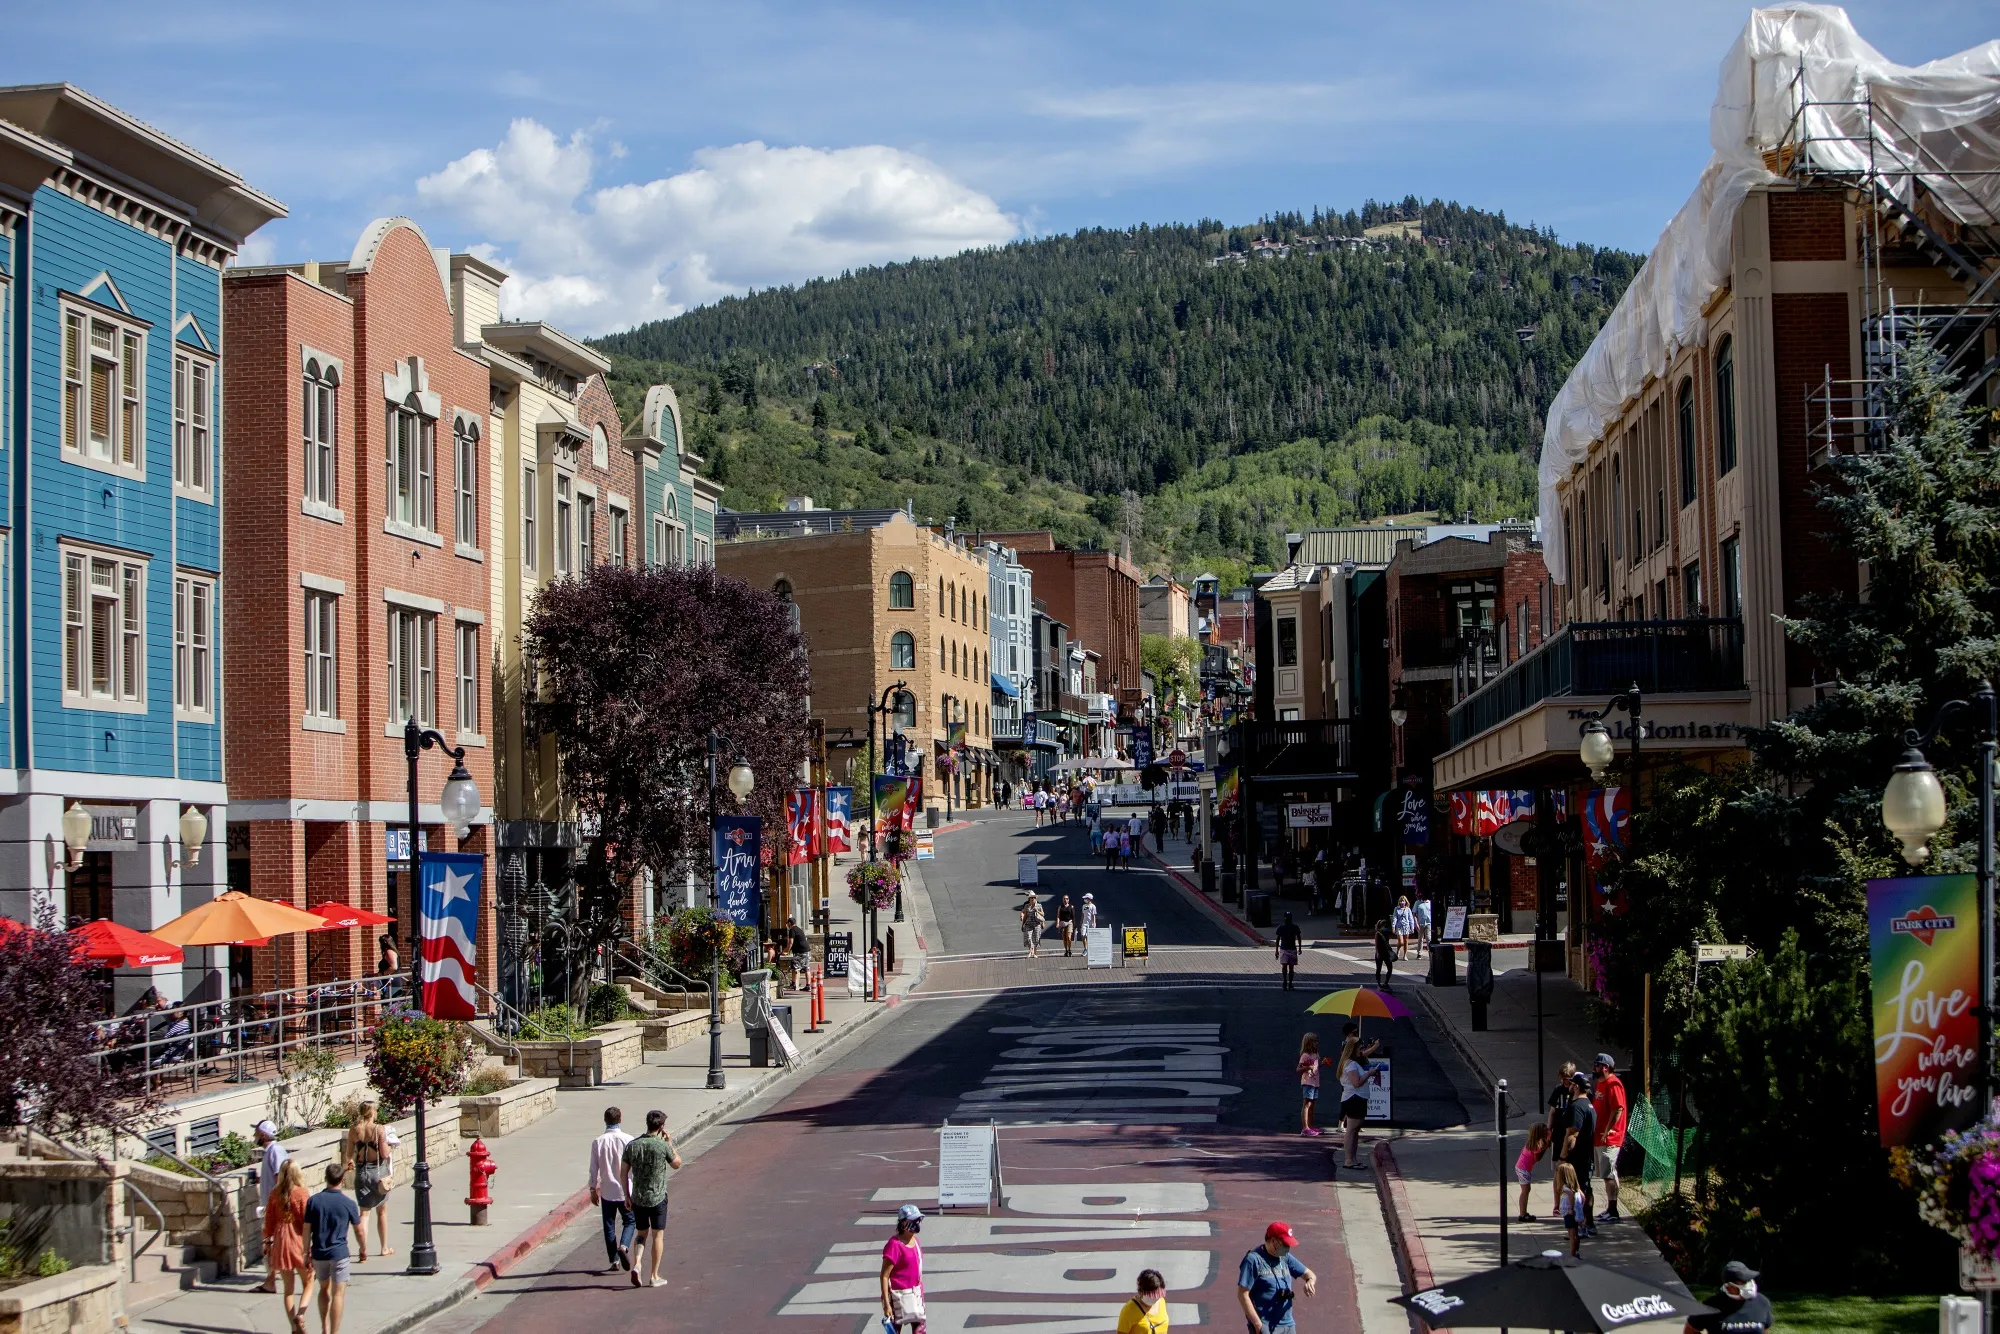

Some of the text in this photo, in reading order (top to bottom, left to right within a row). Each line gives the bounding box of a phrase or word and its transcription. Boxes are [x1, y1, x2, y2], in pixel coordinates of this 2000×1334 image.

[1568, 709, 1592, 719] The
[874, 798, 900, 826] Love
[1397, 790, 1426, 820] Love
[721, 848, 756, 876] Ama
[721, 875, 730, 891] el
[1896, 918, 1952, 930] PARK CITY
[829, 953, 848, 962] OPEN
[1875, 960, 1971, 1064] Love
[1918, 1035, 1977, 1071] where
[1892, 1072, 1977, 1116] you live
[1601, 1294, 1677, 1323] Coca-Cola
